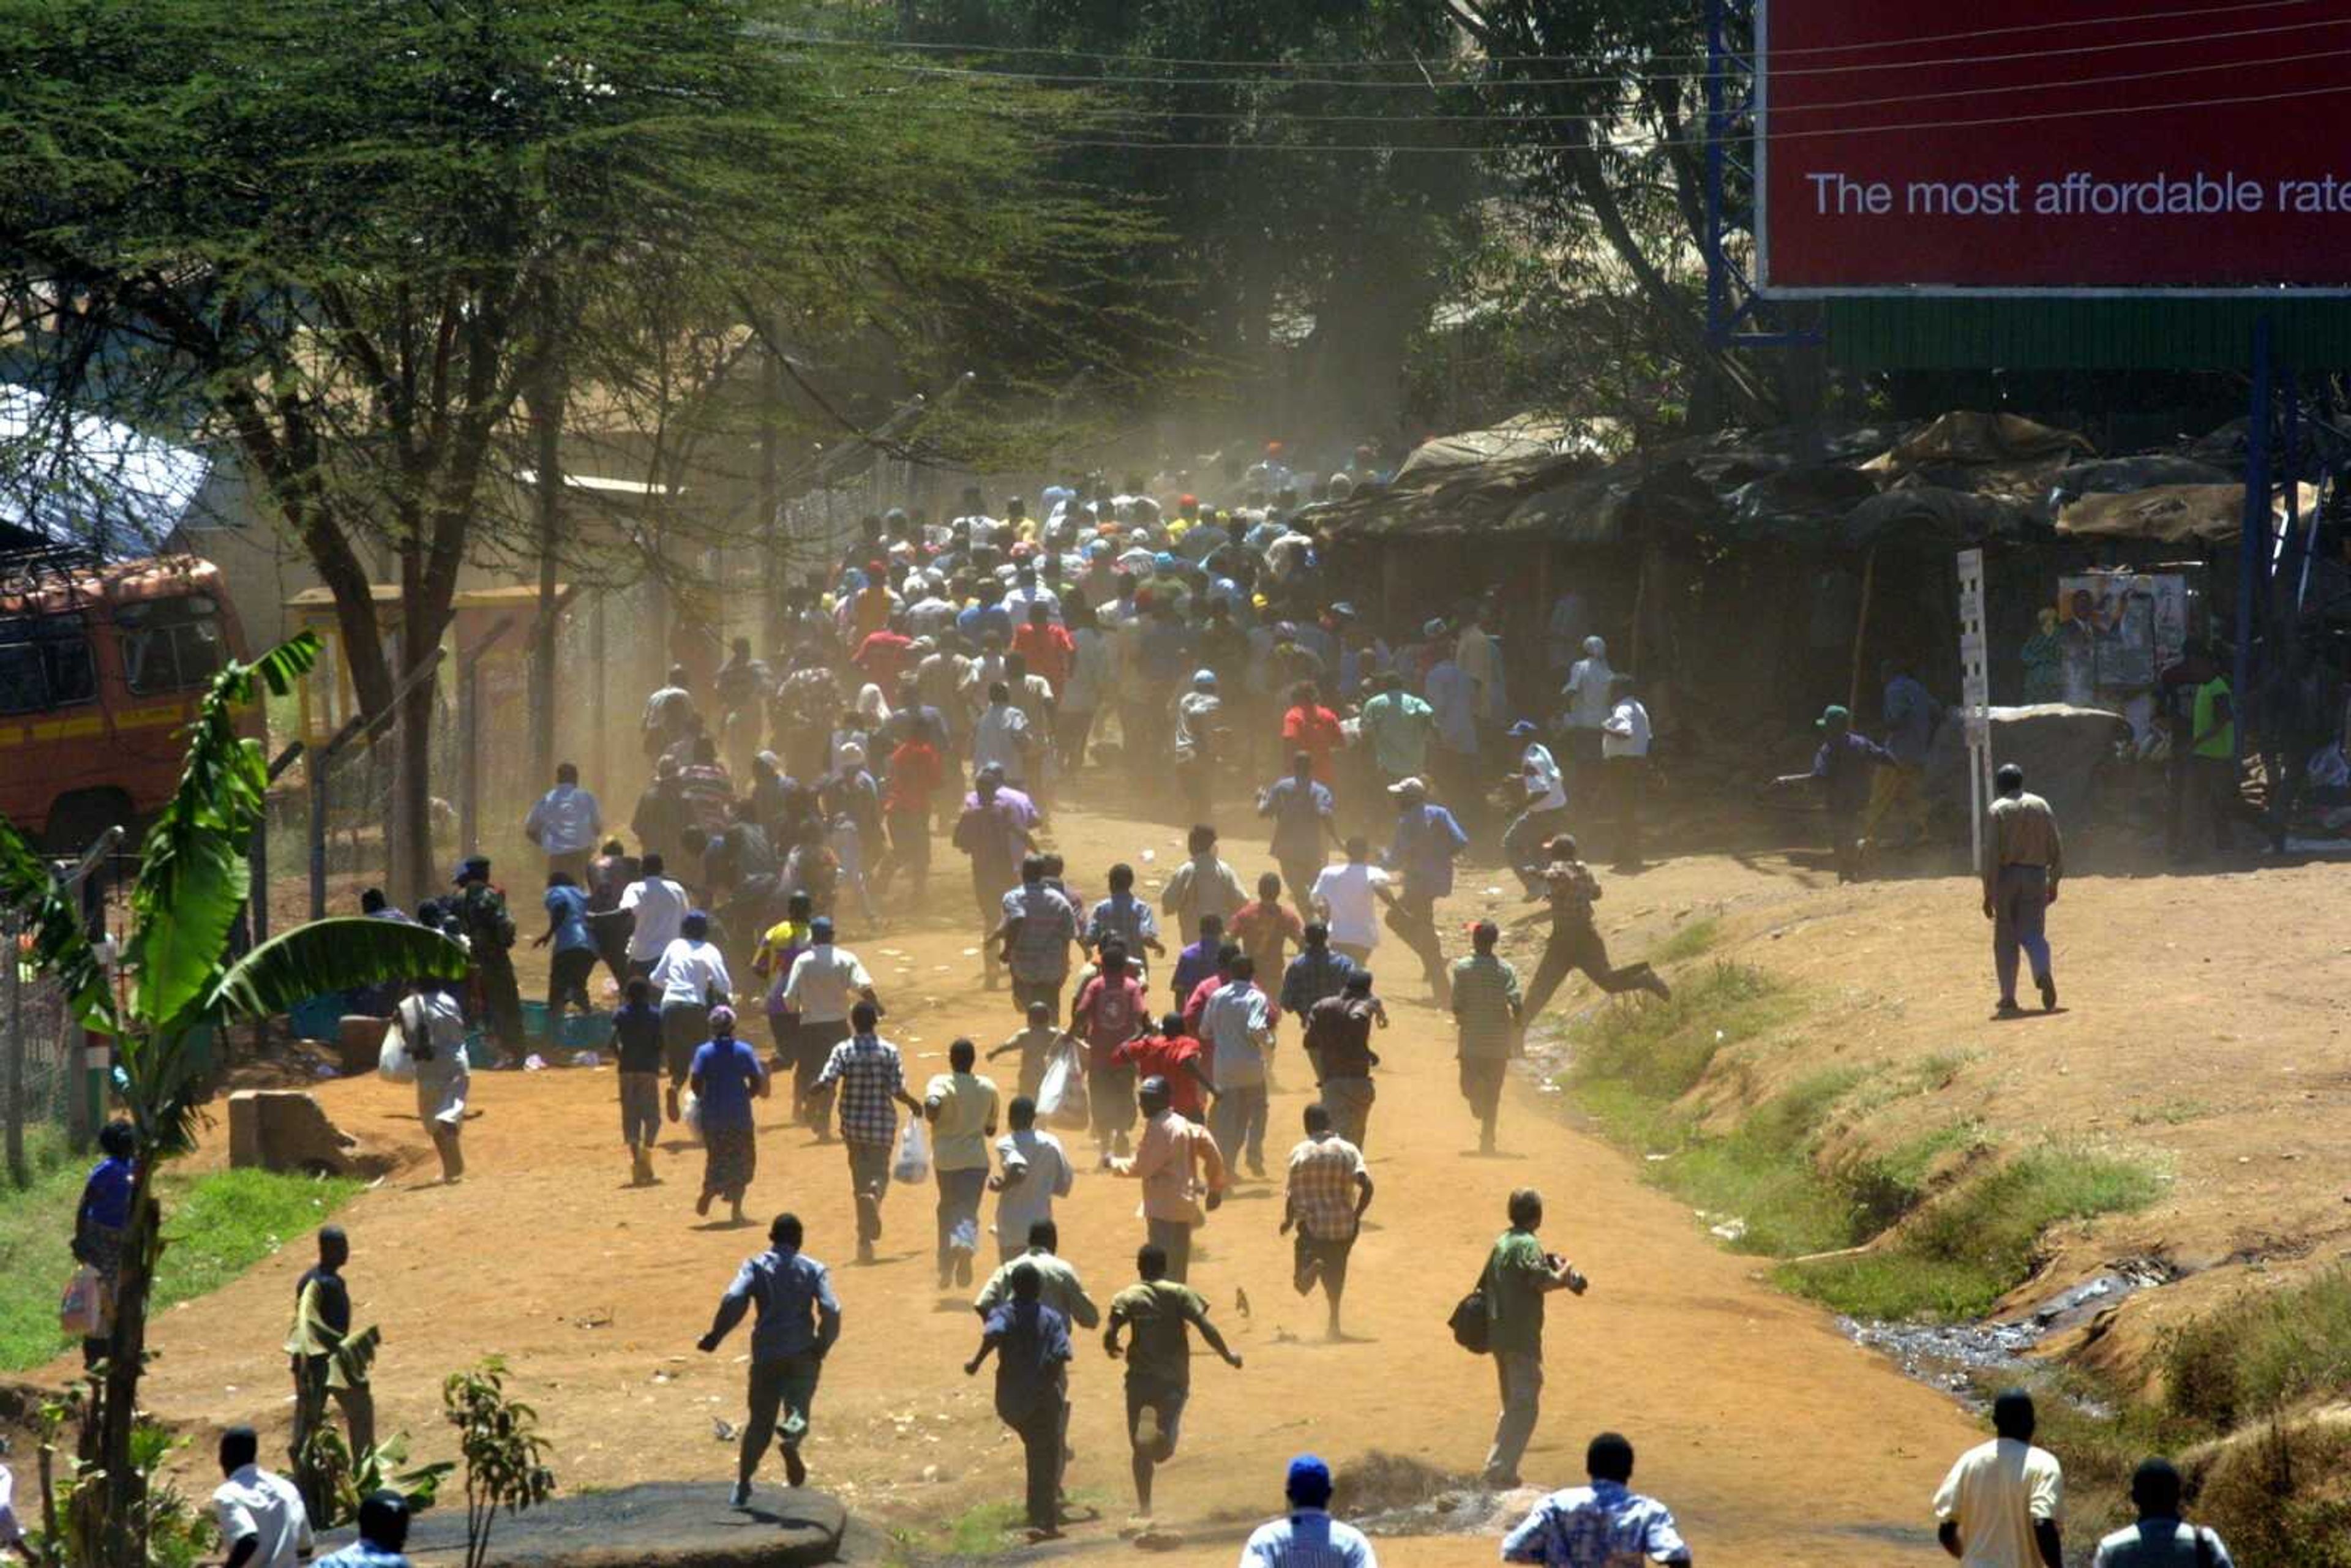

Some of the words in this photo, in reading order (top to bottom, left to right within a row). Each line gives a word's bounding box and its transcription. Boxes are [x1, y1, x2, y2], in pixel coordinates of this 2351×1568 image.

[1805, 173, 1892, 214] The
[1908, 176, 2020, 214] most
[2035, 171, 2263, 214] affordable
